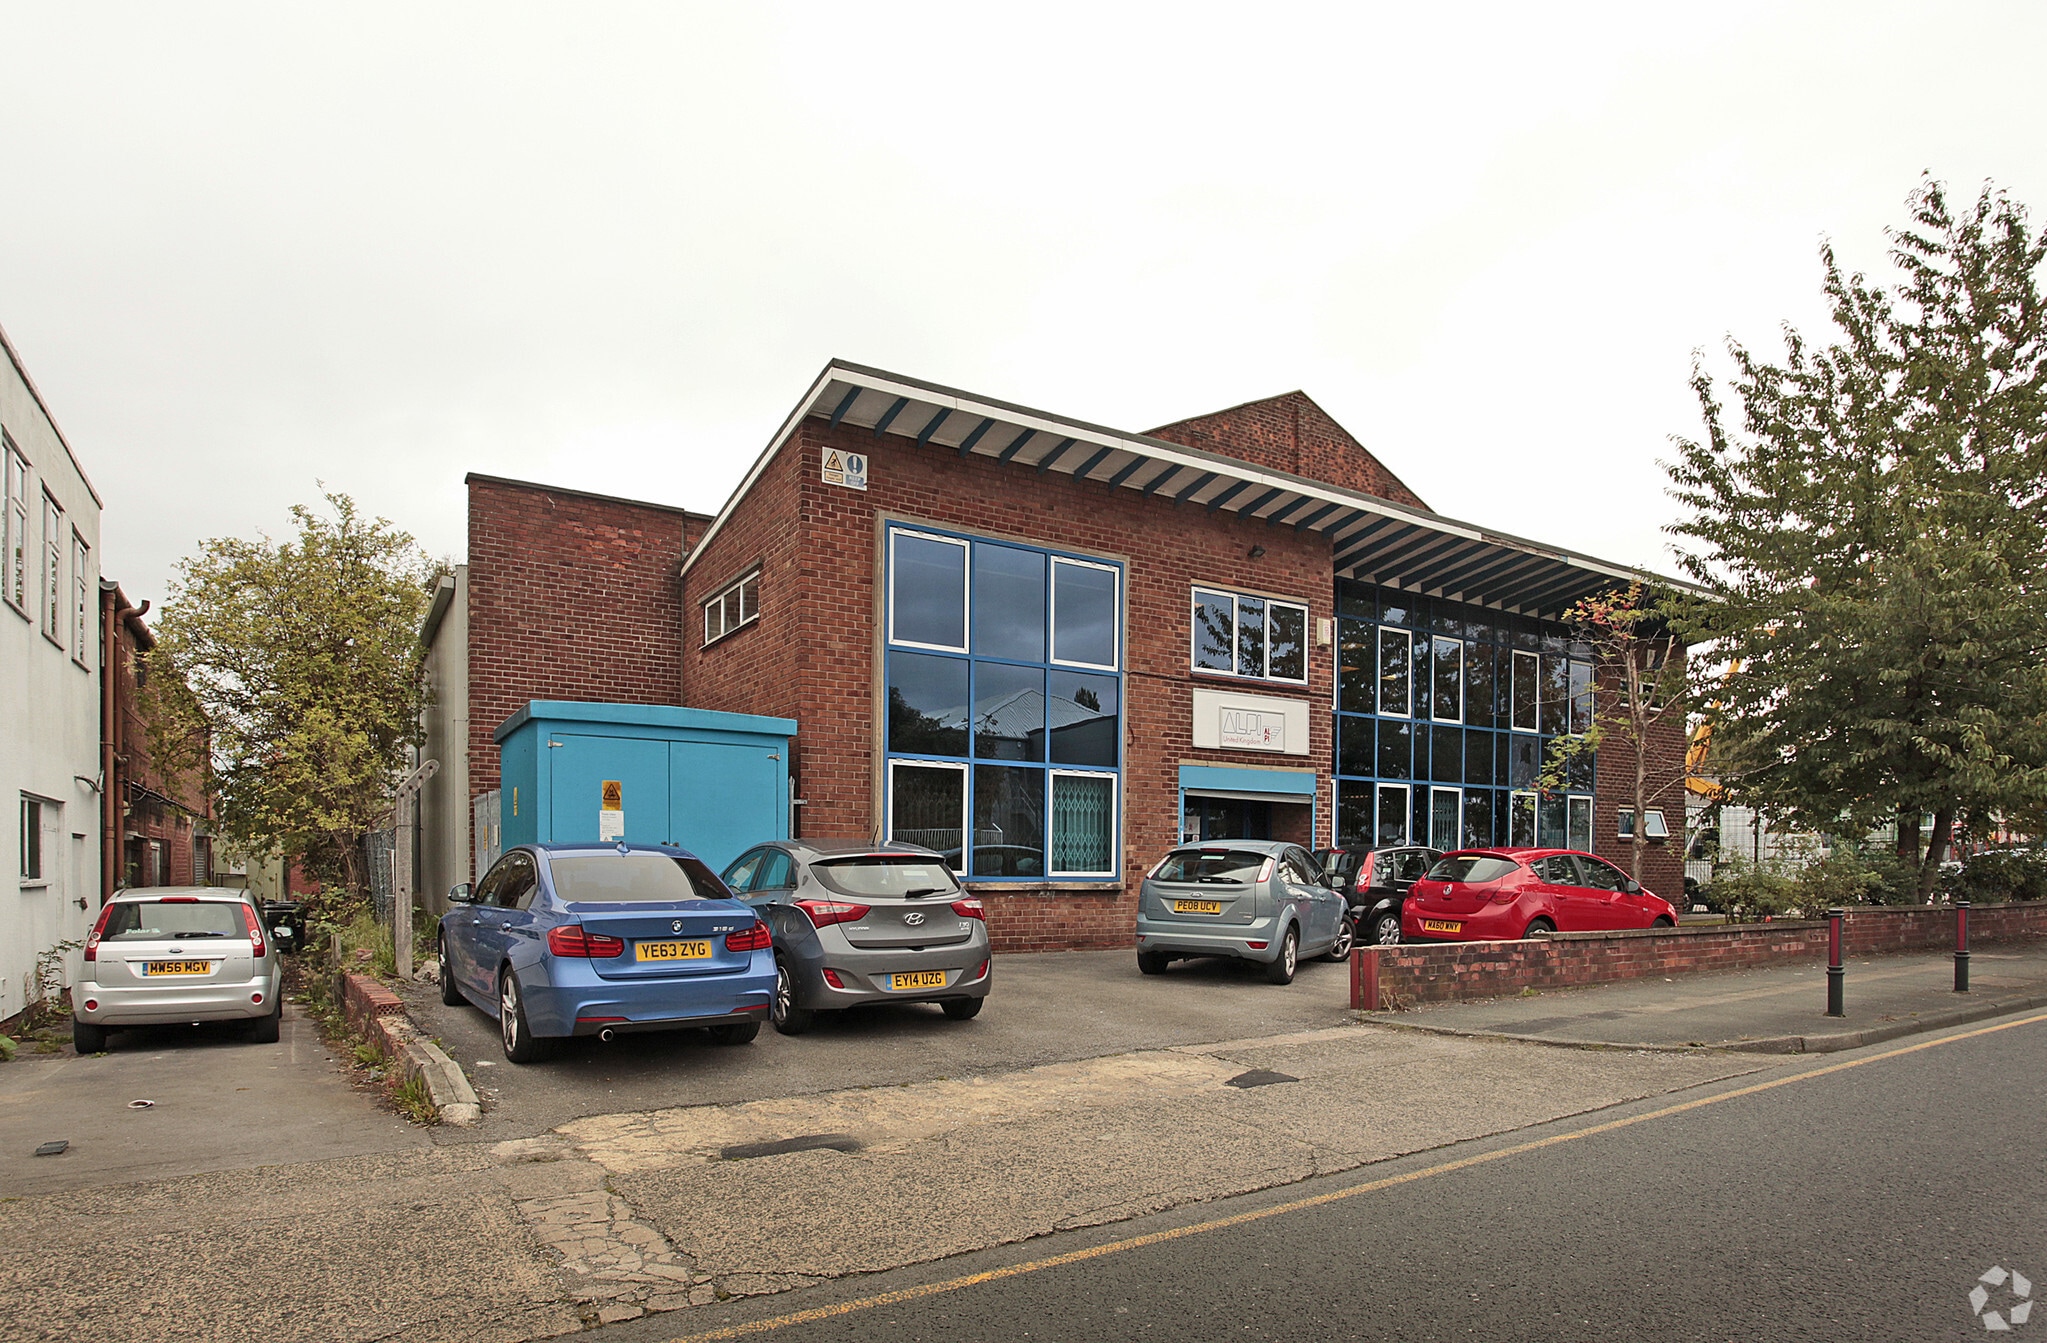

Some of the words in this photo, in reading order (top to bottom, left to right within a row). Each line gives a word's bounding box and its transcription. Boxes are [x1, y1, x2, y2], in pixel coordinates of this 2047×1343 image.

[1223, 711, 1262, 736] ALPI
[1223, 735, 1239, 743] United
[1239, 736, 1261, 746] Kingdom
[1177, 900, 1199, 910] PE08
[1200, 901, 1218, 911] UCV
[641, 944, 677, 958] YE63
[680, 942, 706, 957] ZYG
[150, 962, 182, 973] MW56
[184, 961, 209, 972] MGV
[895, 975, 919, 987] EY14
[922, 972, 942, 985] UZG
